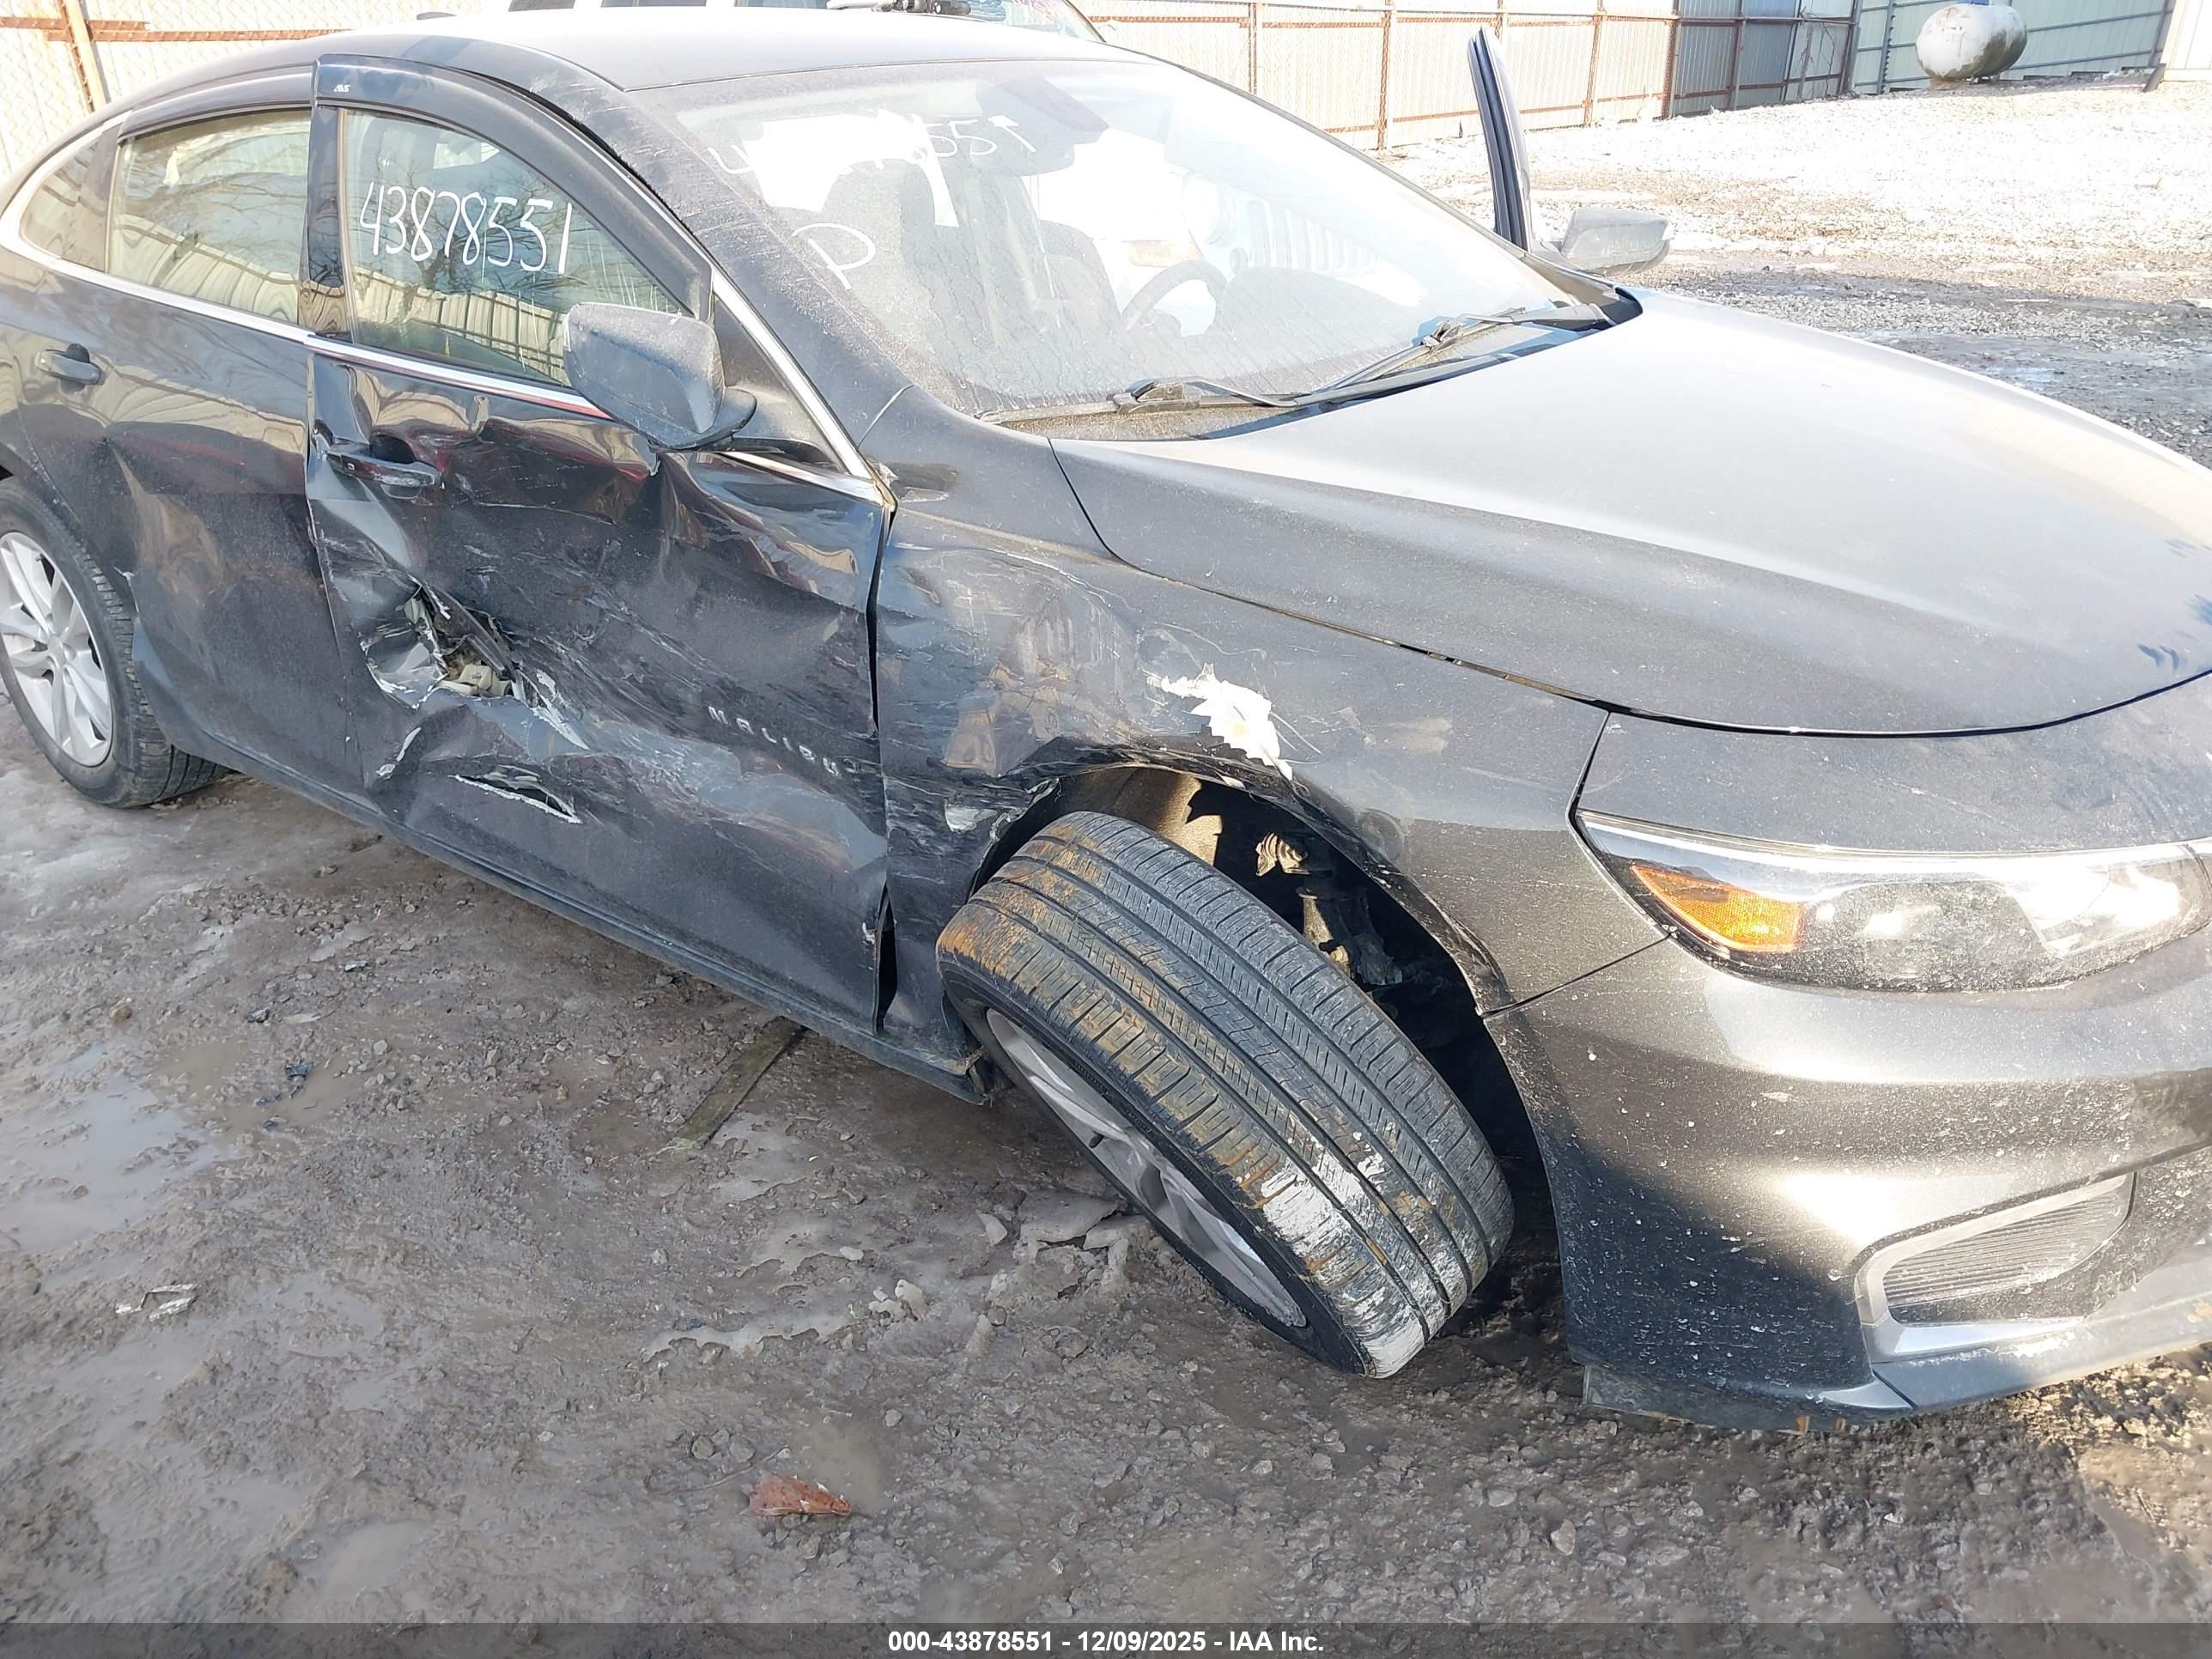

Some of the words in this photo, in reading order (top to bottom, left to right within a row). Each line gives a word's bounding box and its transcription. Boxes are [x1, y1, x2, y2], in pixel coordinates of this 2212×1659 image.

[359, 181, 573, 275] 43878551
[790, 222, 876, 290] P
[708, 706, 840, 777] MALIBU
